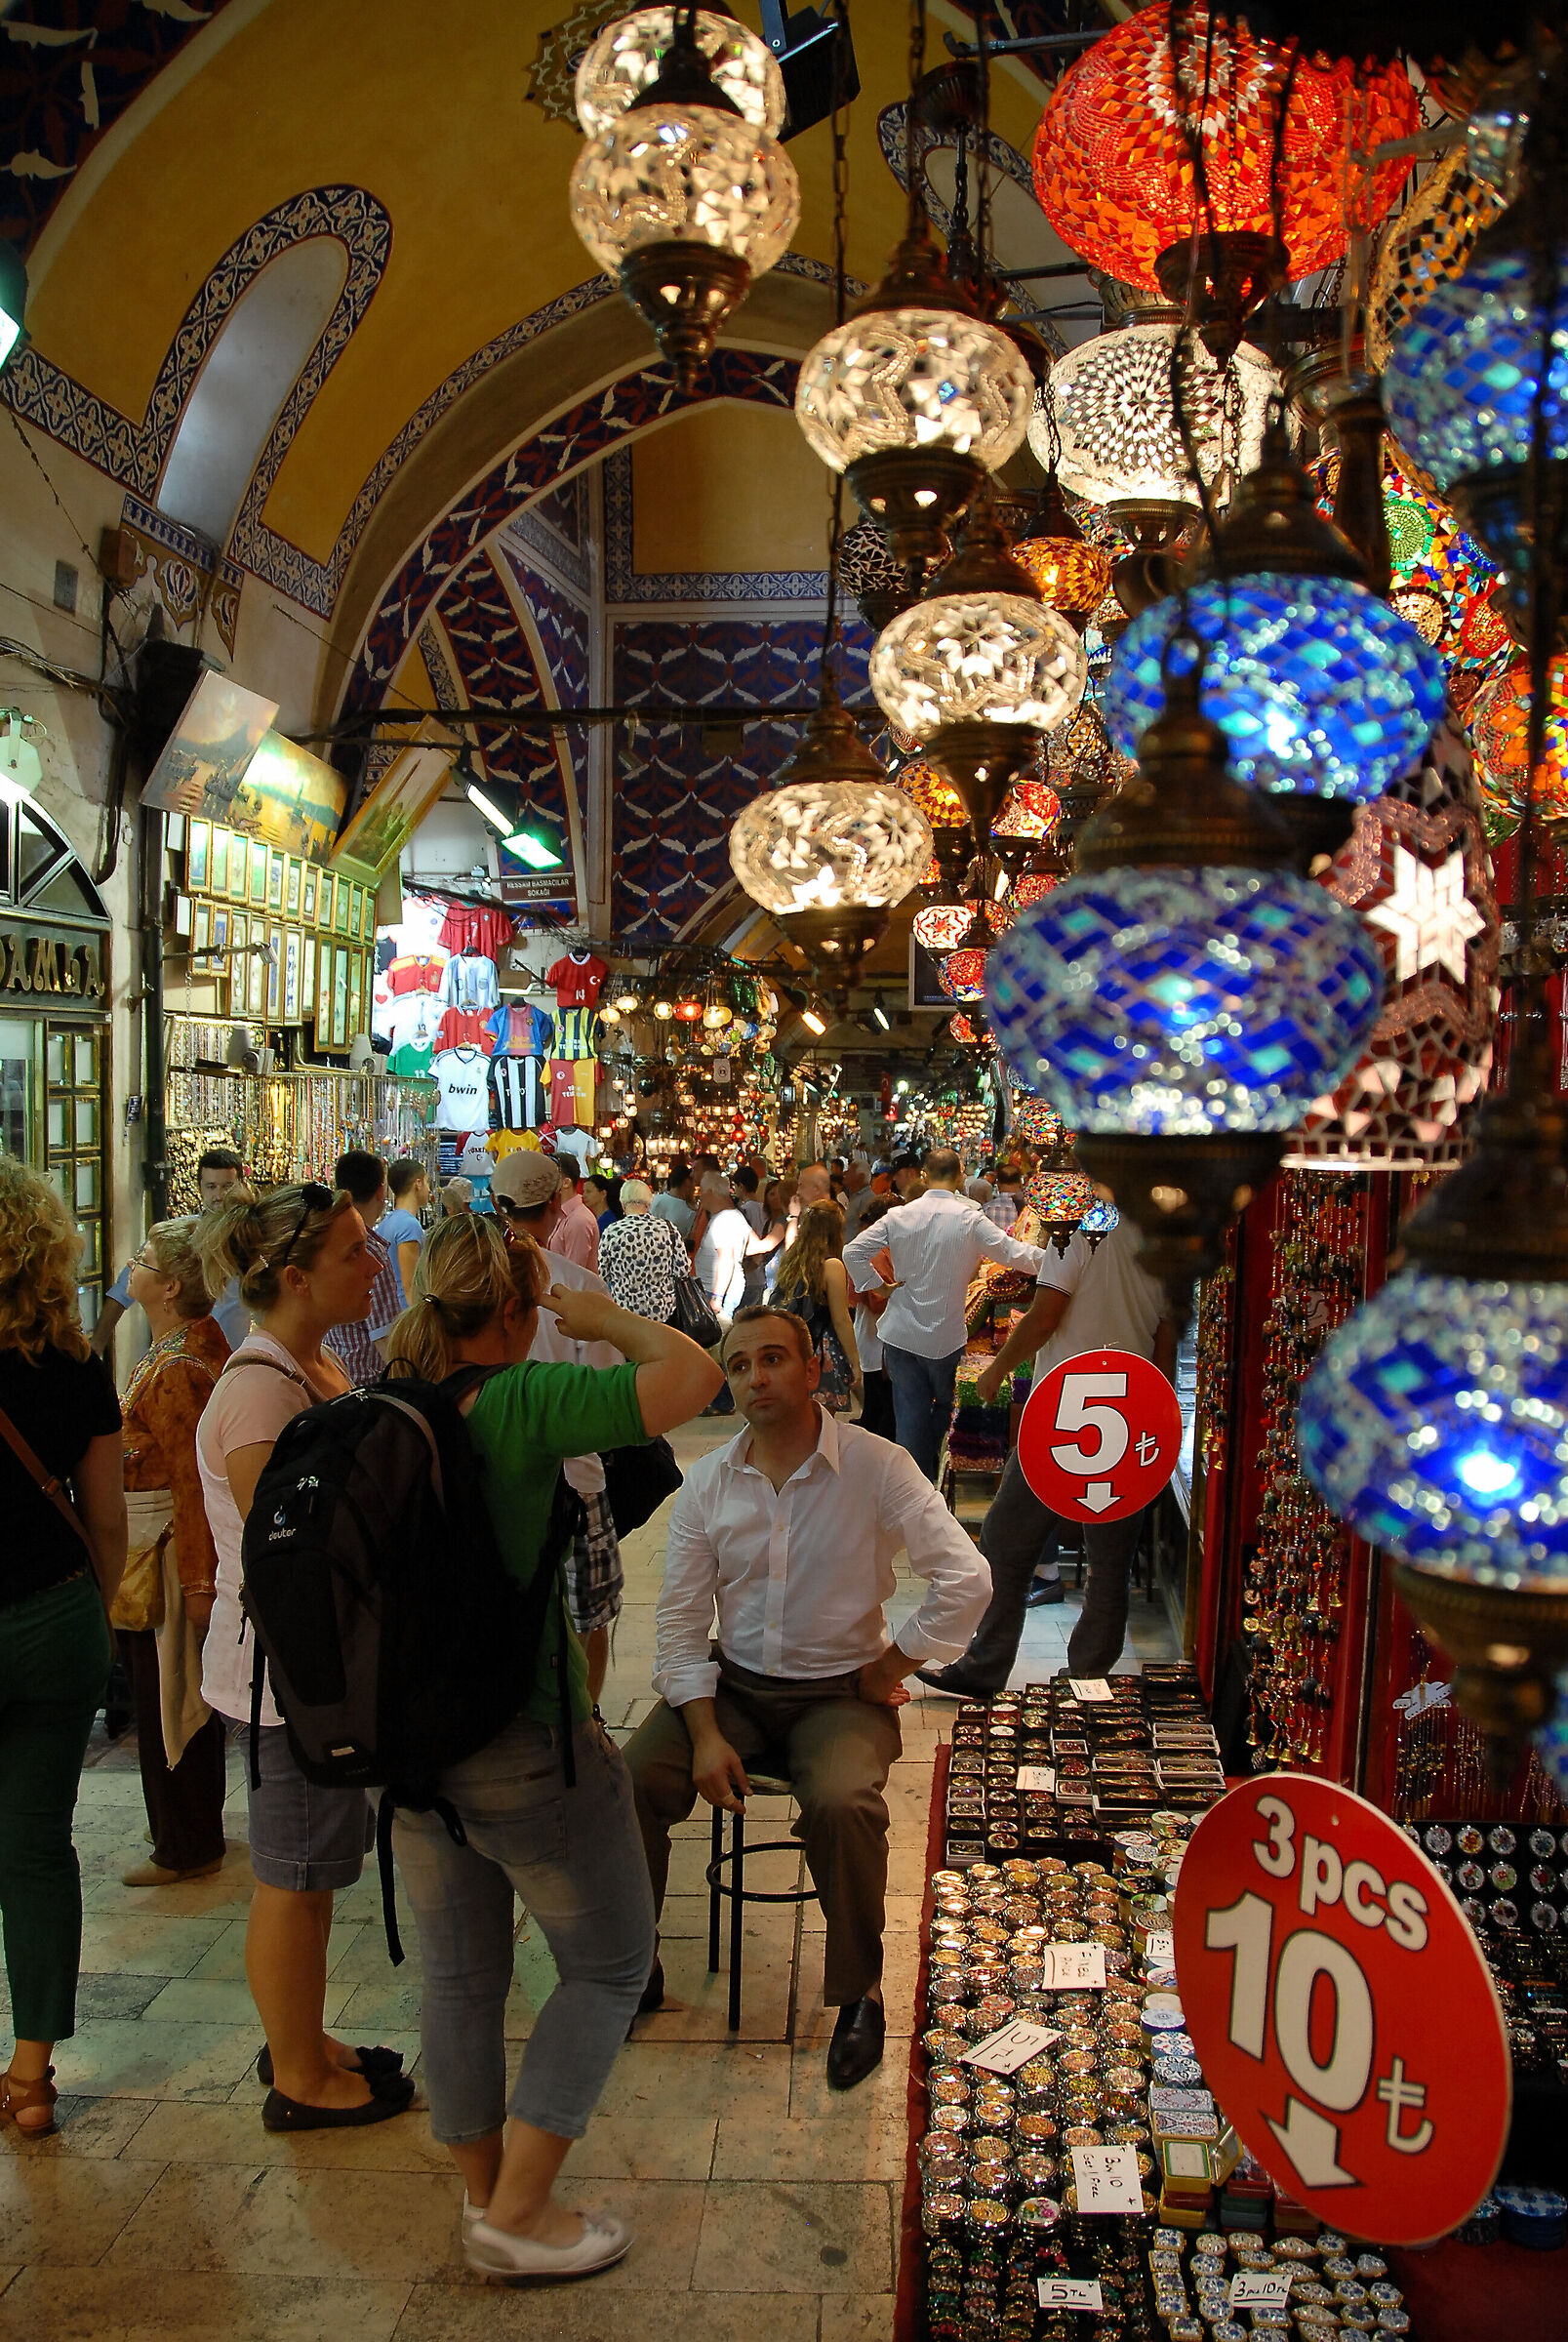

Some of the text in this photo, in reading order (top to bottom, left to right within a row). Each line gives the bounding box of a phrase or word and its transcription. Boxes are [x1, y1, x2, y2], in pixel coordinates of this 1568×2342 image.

[527, 887, 550, 897] SOKAĞI
[448, 1083, 477, 1095] bwin
[1050, 1373, 1130, 1476] 5
[268, 1527, 297, 1541] deuter
[1252, 1795, 1429, 1953] 3 pcs
[1206, 1890, 1374, 2113] 10
[1109, 2176, 1123, 2187] 10
